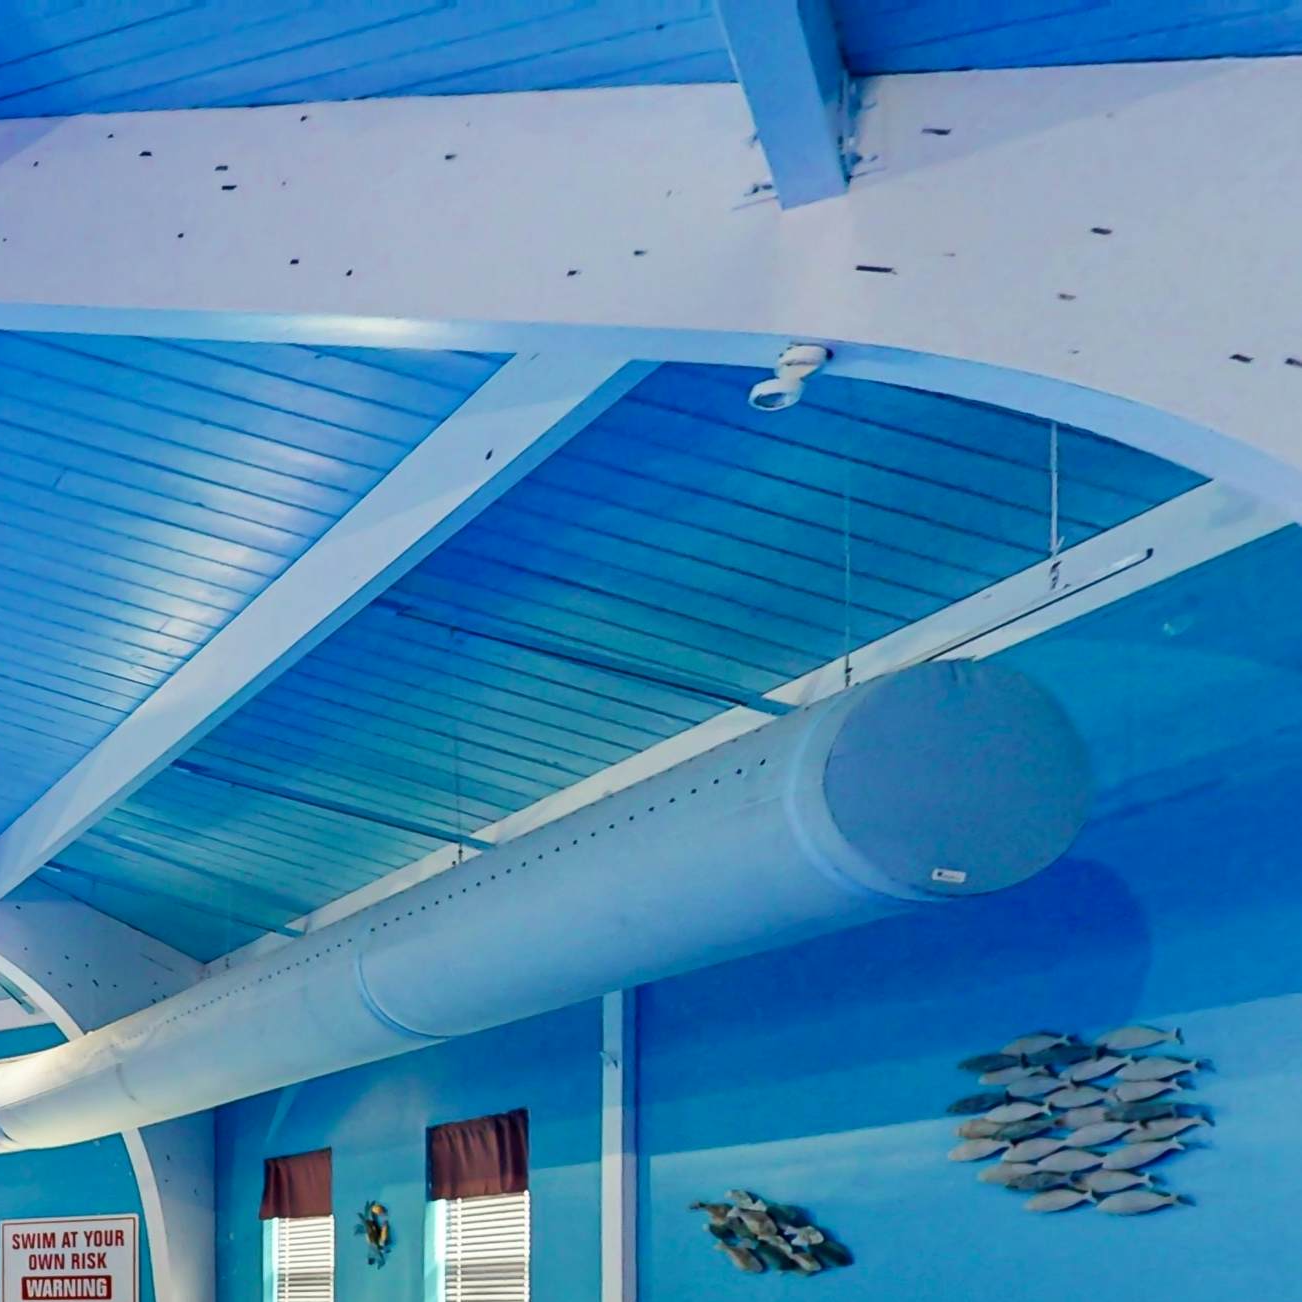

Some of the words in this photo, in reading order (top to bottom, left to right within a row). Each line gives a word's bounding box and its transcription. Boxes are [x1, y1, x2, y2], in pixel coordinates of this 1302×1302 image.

[12, 1232, 56, 1249] SWIM
[61, 1231, 78, 1248] AT
[84, 1229, 124, 1247] YOUR
[28, 1253, 65, 1270] OWN
[71, 1252, 107, 1269] RISK
[25, 1278, 107, 1298] WARNING
